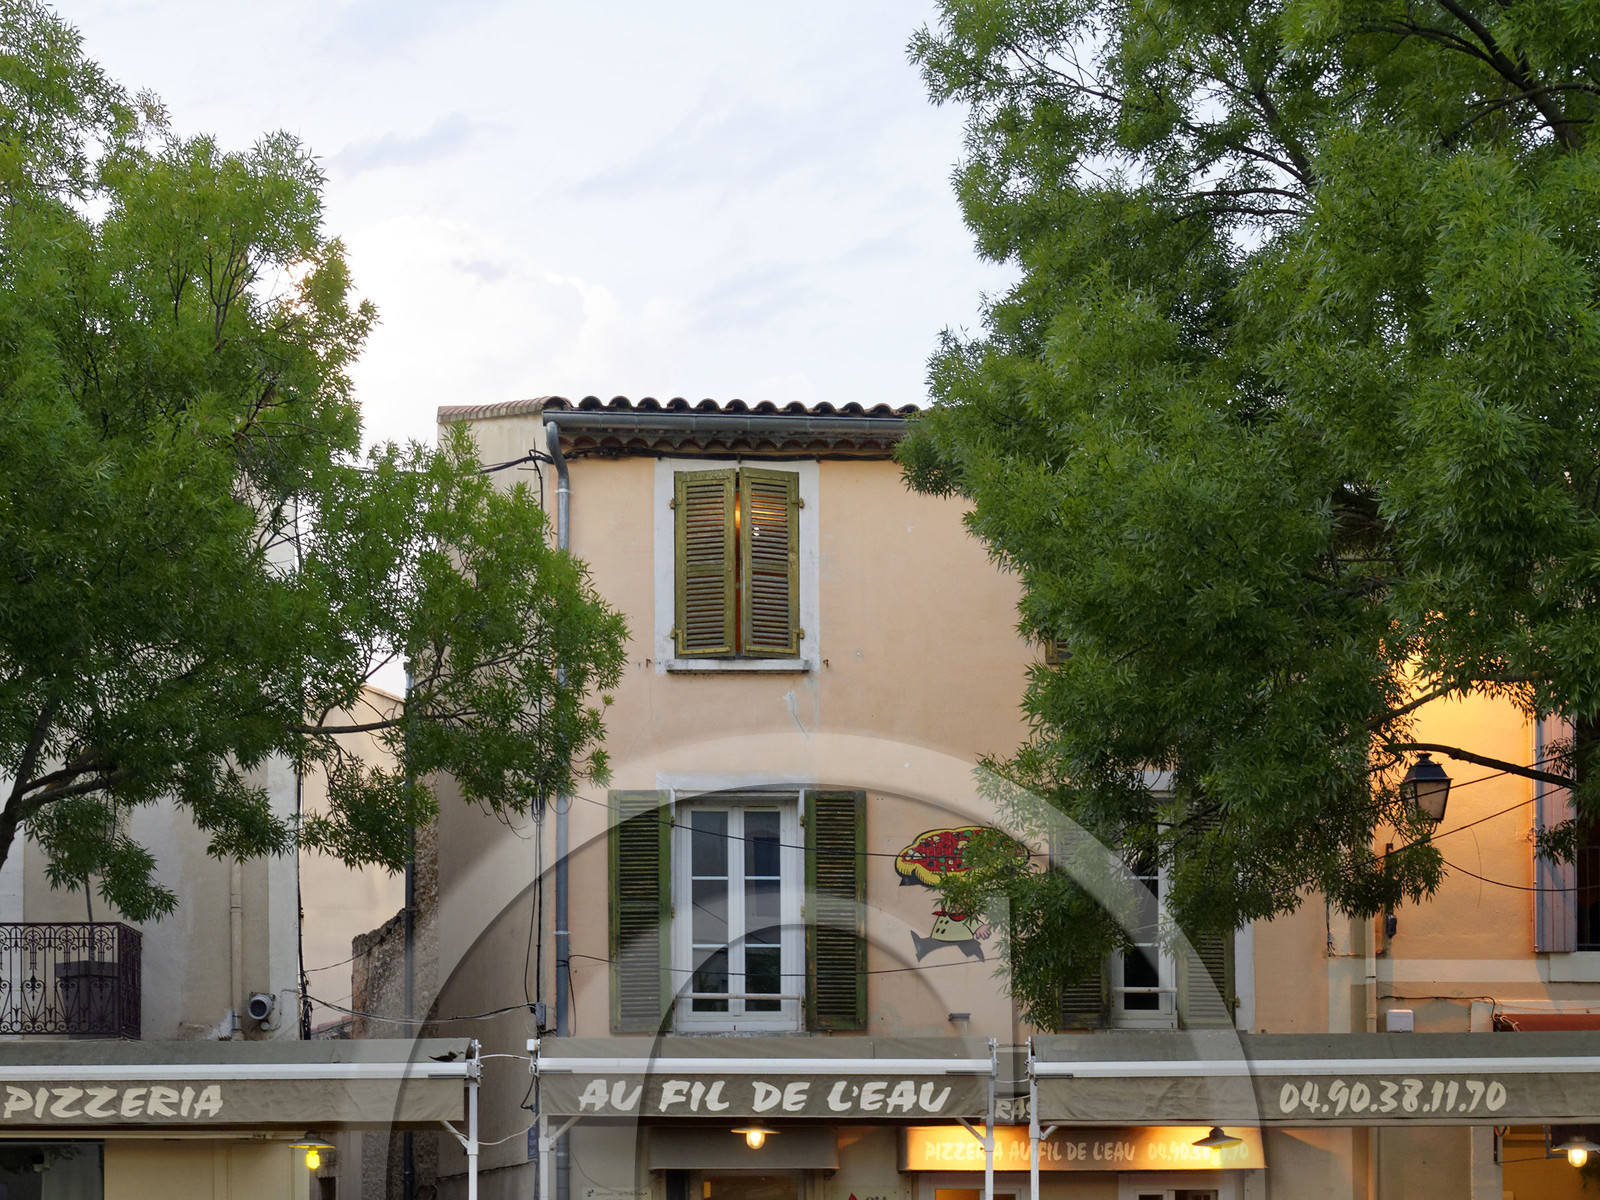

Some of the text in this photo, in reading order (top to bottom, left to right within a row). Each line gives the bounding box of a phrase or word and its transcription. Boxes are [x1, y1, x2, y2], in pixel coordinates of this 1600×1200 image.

[3, 1085, 223, 1119] PIZZERIA
[578, 1079, 952, 1114] AU FIL DE L'EAU
[1279, 1078, 1507, 1116] 04.90.38.11.70
[924, 1141, 1004, 1161] PIZZERA
[1038, 1142, 1062, 1161] FIL
[1066, 1142, 1087, 1161] DE
[1093, 1141, 1135, 1162] L'EAU
